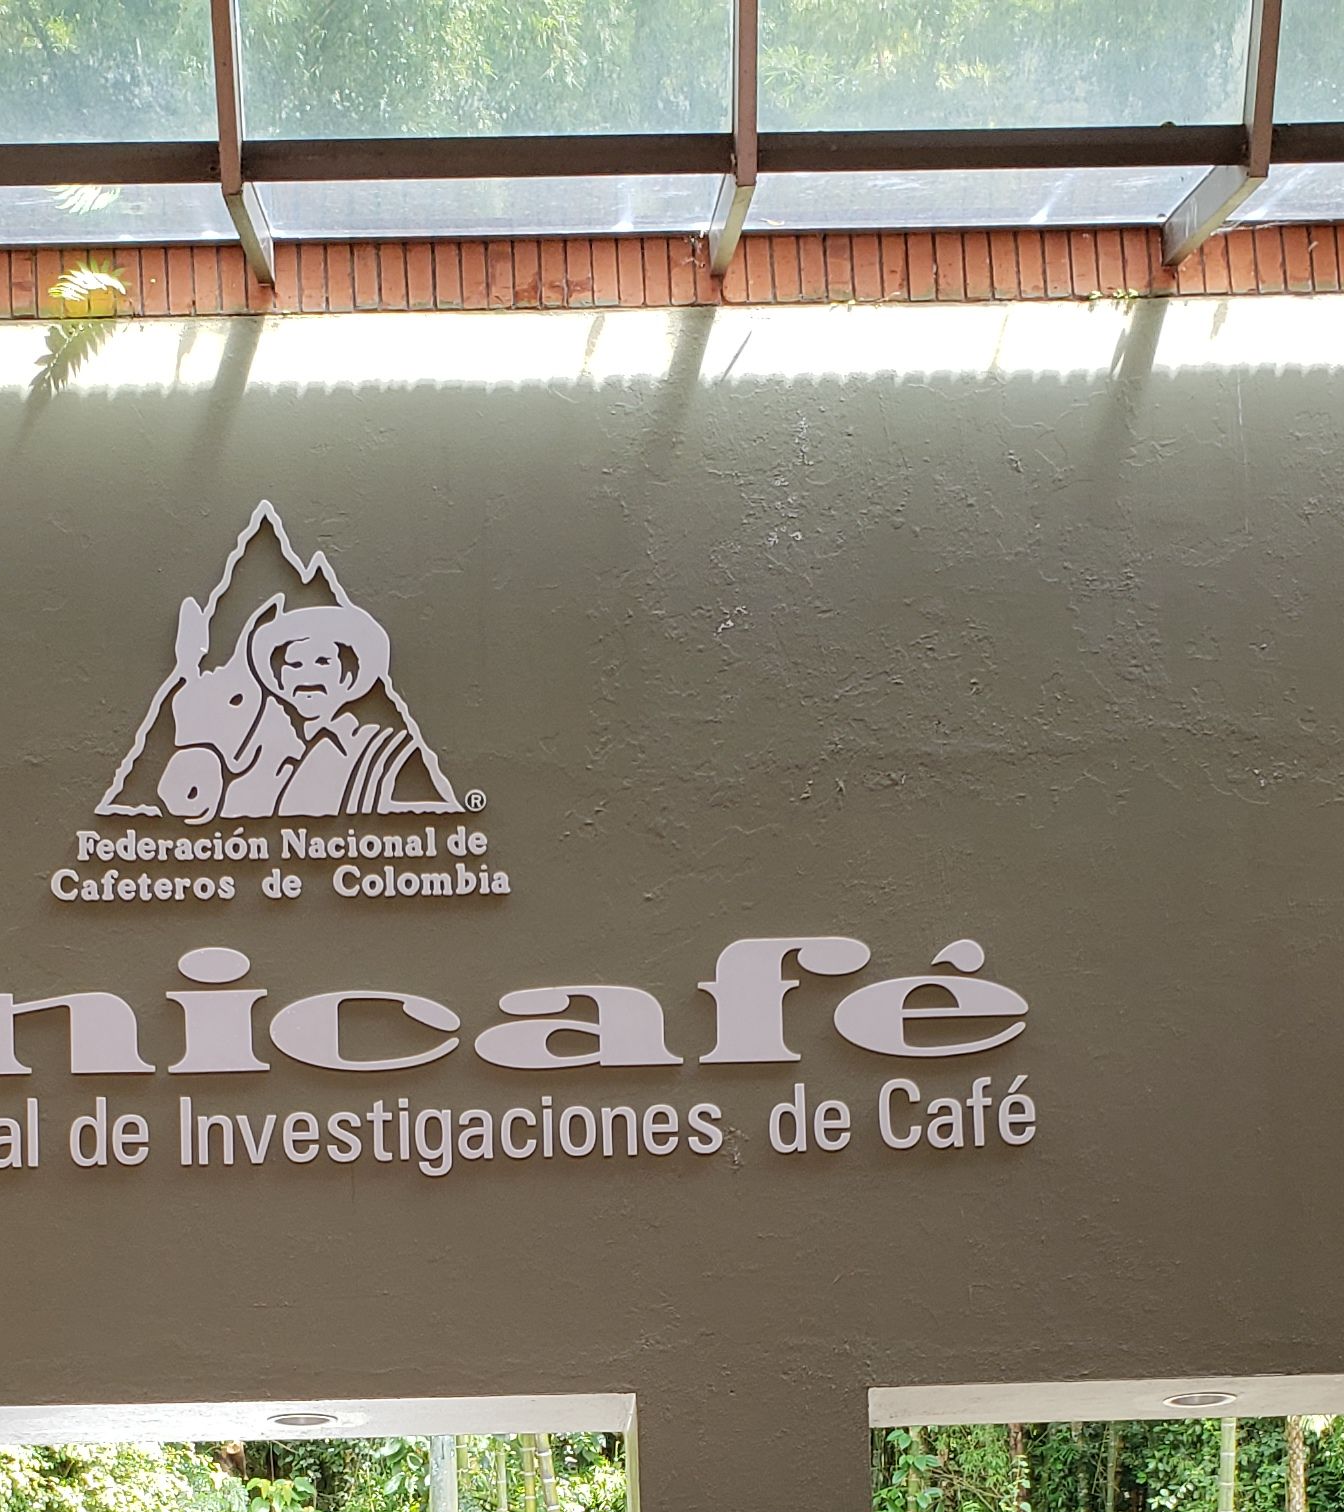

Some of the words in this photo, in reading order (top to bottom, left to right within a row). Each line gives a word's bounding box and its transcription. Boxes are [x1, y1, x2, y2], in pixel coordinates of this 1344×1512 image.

[76, 827, 269, 861] Federación
[280, 826, 437, 859] Nacional
[447, 826, 488, 856] de
[50, 868, 236, 901] Cafeteros
[261, 868, 302, 898] de
[332, 862, 511, 897] Colombia
[69, 1096, 150, 1167] de
[179, 1095, 723, 1176] Investigaciones
[769, 1082, 851, 1153] de
[878, 1074, 1036, 1150] Café
